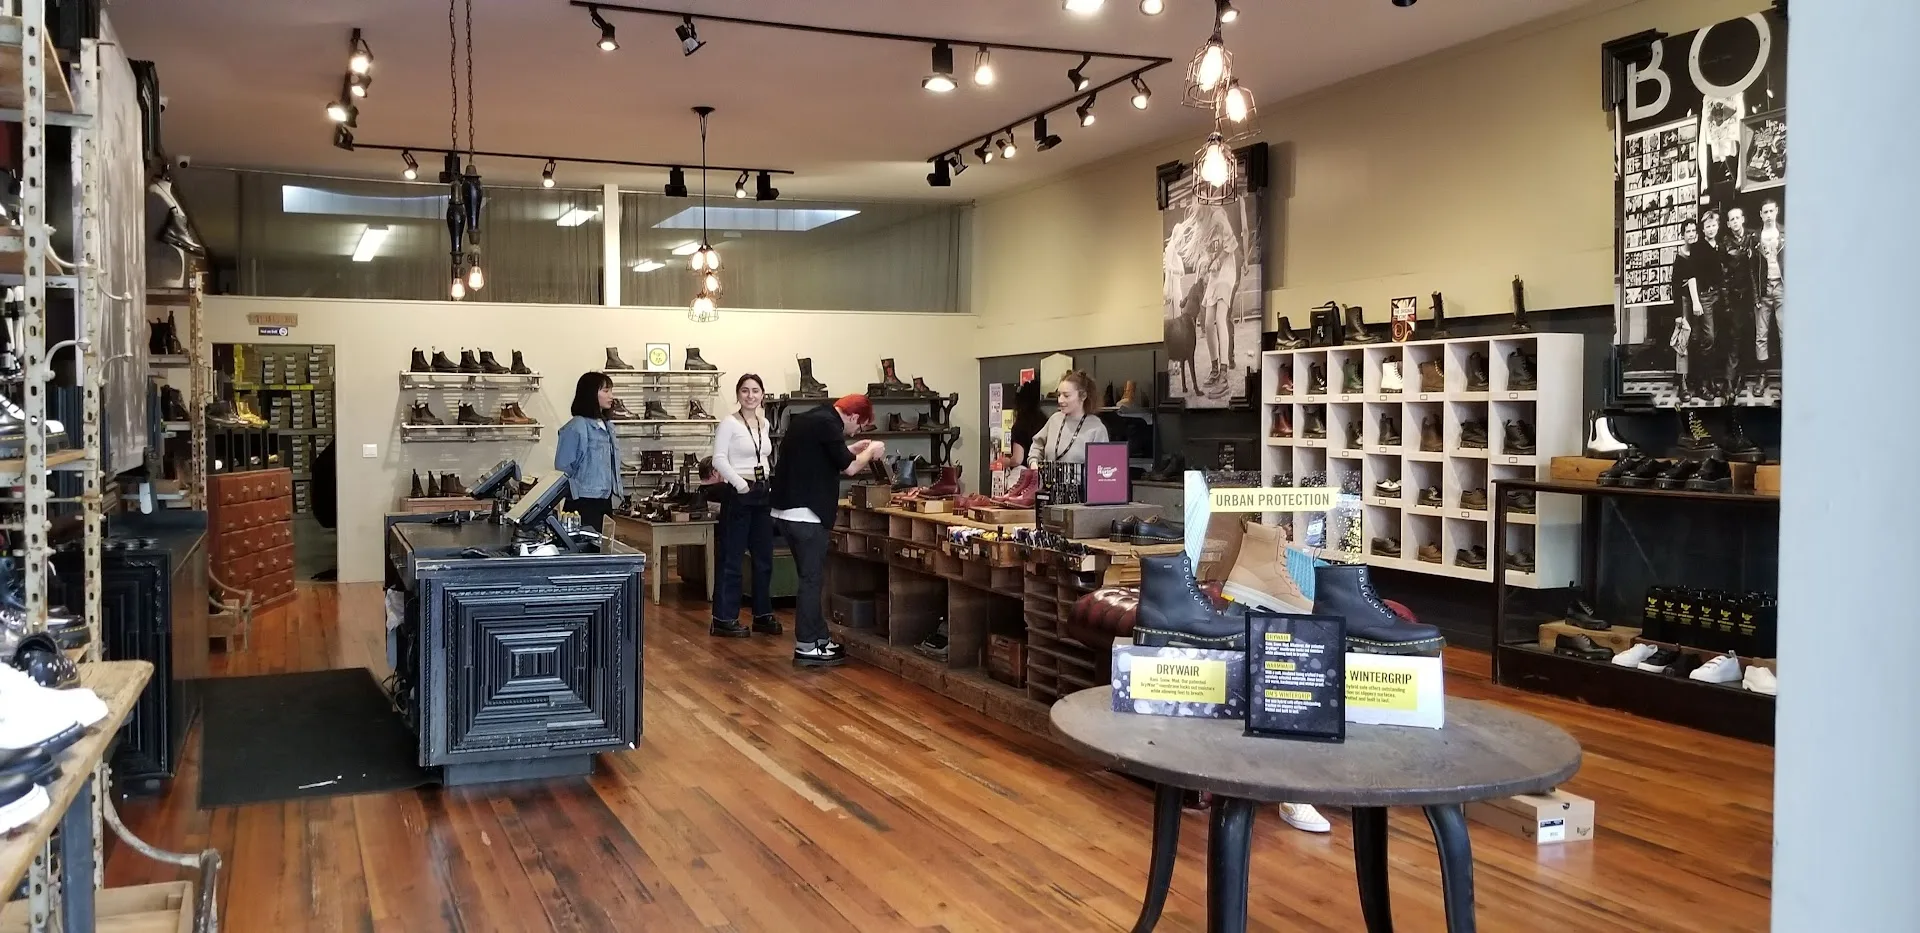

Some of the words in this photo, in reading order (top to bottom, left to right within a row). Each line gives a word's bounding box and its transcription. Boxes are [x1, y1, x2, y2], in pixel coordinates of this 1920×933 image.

[1216, 494, 1254, 506] URBAN
[1258, 493, 1330, 506] PROTECTION
[1156, 663, 1200, 677] DRYWAIR
[1349, 670, 1412, 684] WINTERGRIP
